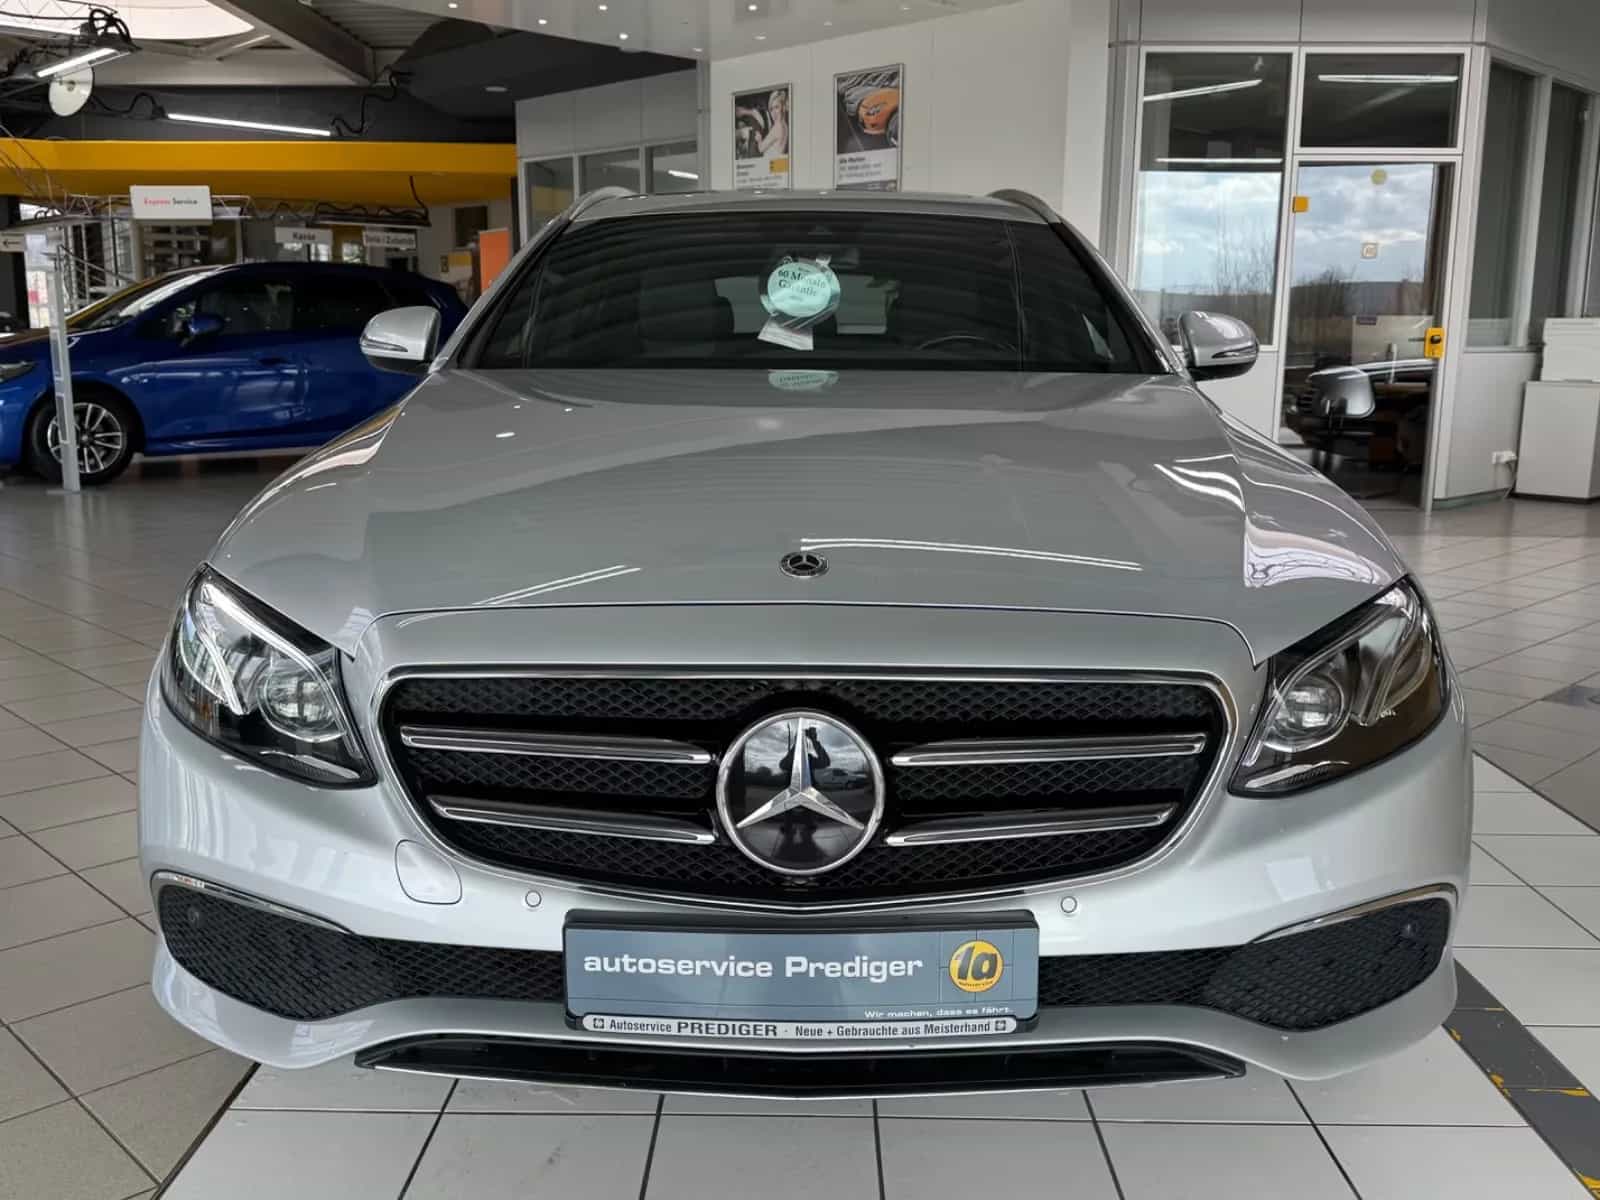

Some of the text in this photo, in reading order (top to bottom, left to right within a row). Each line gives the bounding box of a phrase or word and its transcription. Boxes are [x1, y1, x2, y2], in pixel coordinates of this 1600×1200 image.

[583, 953, 924, 983] autoservice Prediger
[957, 945, 998, 981] 1a
[864, 1009, 884, 1019] Wir
[609, 1018, 673, 1034] Autoservice
[677, 1020, 778, 1037] PREDIGER
[795, 1025, 824, 1037] Neue
[836, 1024, 899, 1037] Gebrauchte
[901, 1025, 921, 1036] aus
[923, 1021, 991, 1035] Meisterhand
